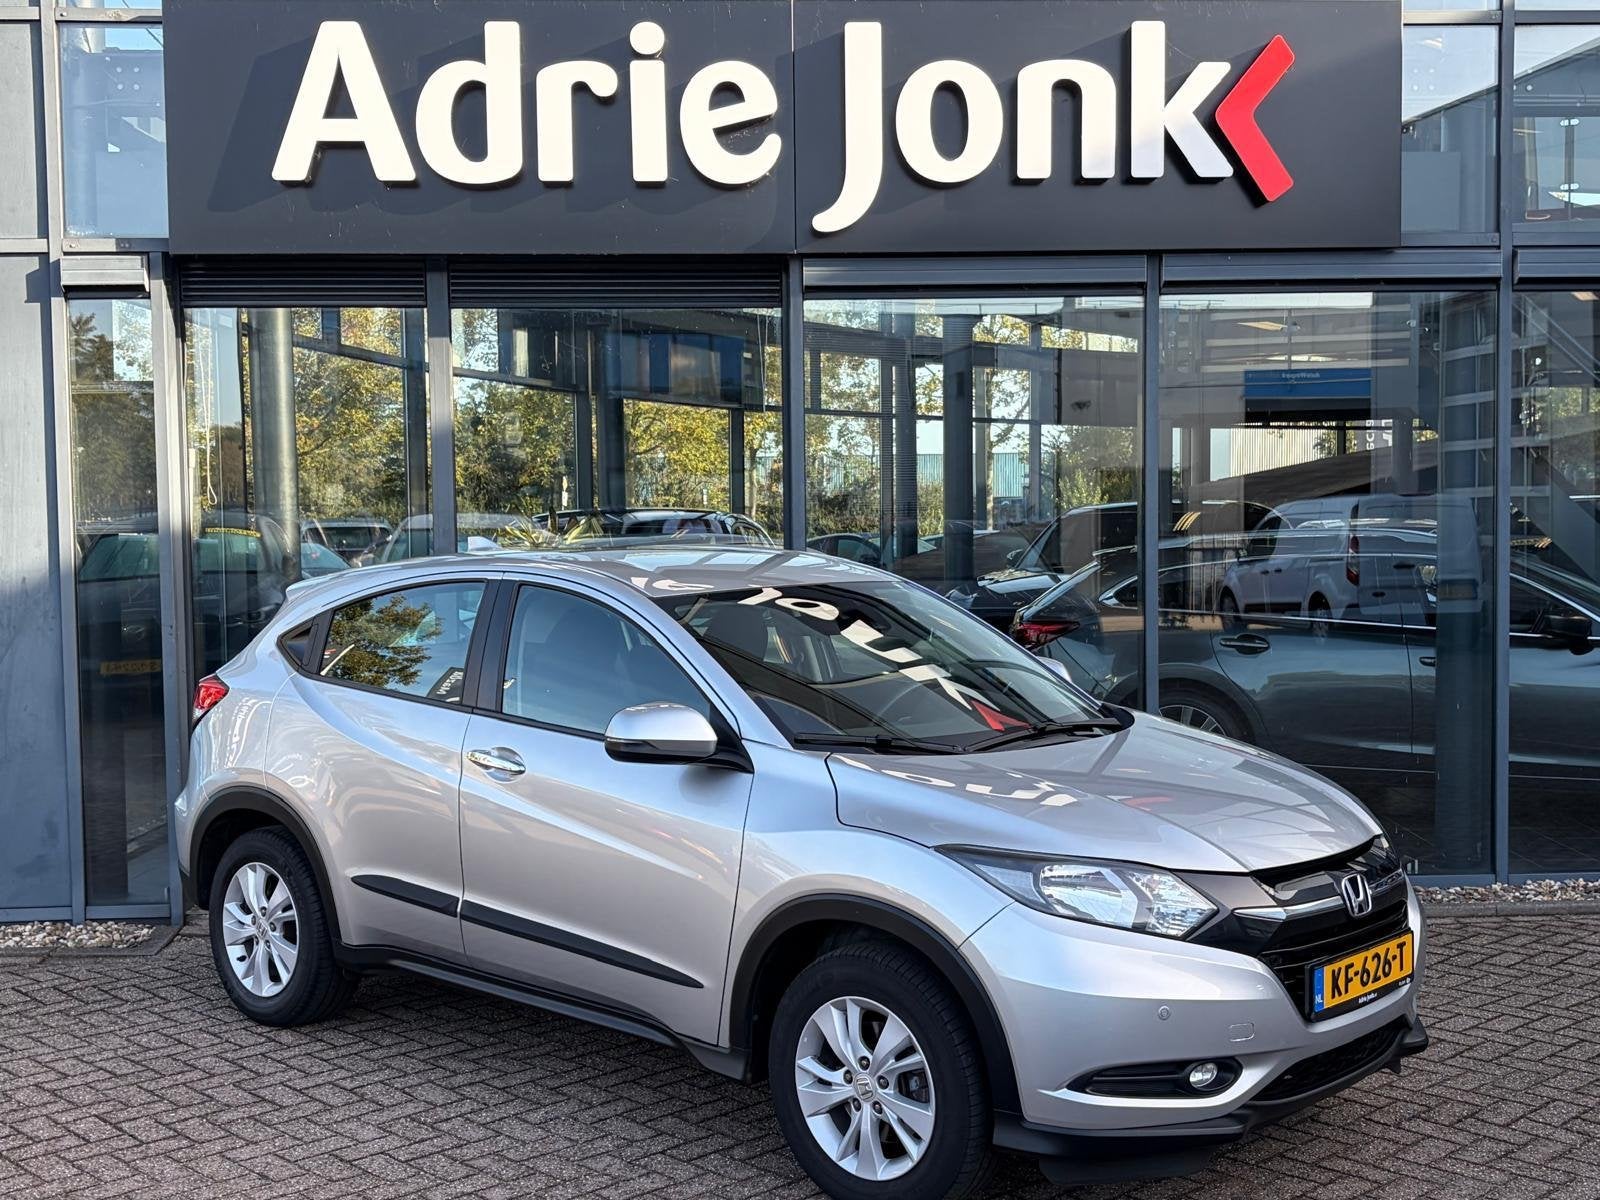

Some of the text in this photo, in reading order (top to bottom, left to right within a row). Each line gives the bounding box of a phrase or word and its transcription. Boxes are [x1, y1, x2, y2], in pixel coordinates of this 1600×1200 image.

[272, 21, 1233, 233] Adrie Jonk
[1315, 941, 1406, 1004] NL KF-626-T
